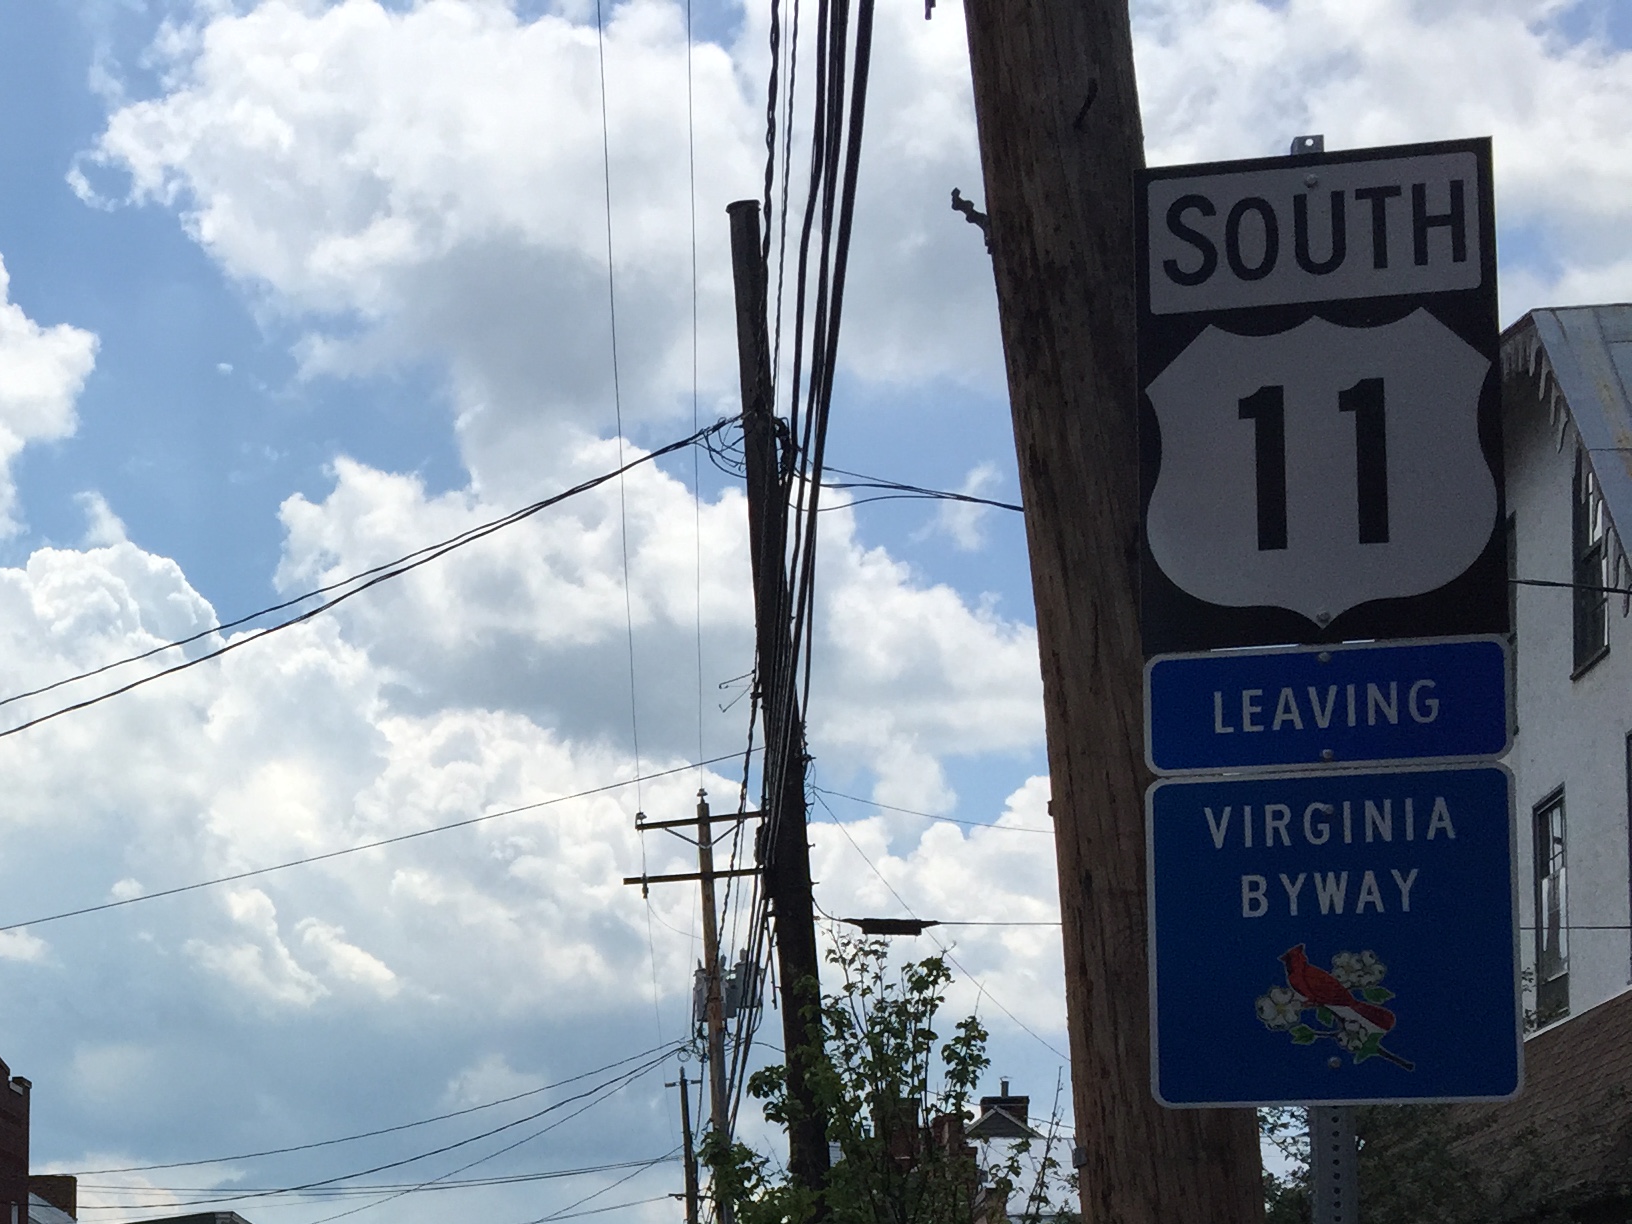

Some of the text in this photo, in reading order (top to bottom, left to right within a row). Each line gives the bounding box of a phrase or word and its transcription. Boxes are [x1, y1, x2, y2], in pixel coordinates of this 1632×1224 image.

[1163, 179, 1467, 286] SOUTH
[1237, 377, 1390, 551] 11
[1213, 678, 1440, 735] LEAVING
[1204, 796, 1457, 849] VIRGINIA
[1241, 868, 1419, 919] BYWAY
